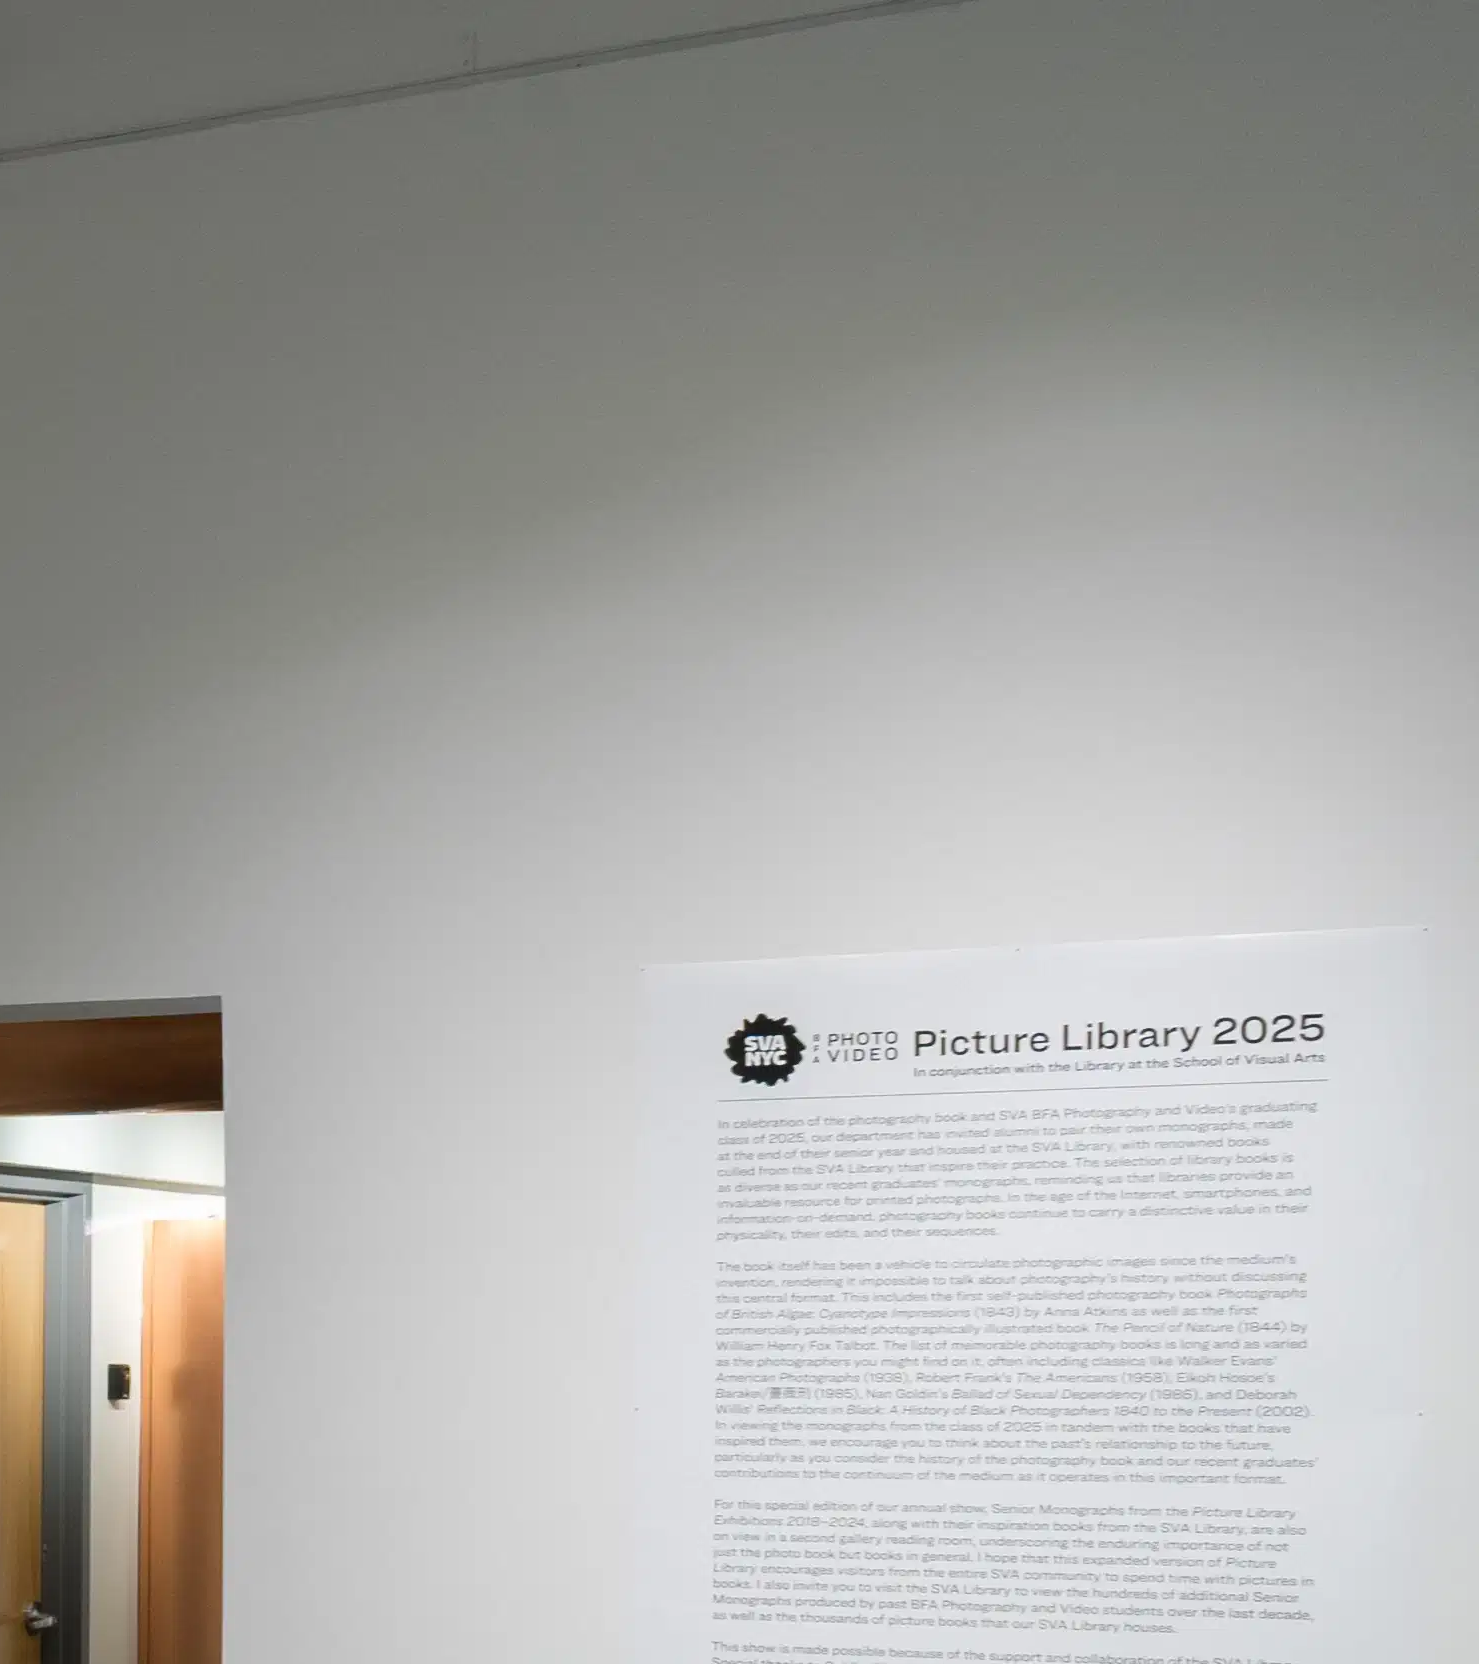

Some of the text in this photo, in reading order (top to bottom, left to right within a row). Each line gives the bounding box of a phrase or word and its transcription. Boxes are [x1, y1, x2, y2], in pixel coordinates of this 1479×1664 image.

[828, 1031, 898, 1046] PHOTO
[914, 1013, 1325, 1057] Picture Library 2025
[744, 1035, 786, 1051] SVA
[745, 1051, 787, 1066] NYC
[828, 1048, 898, 1062] VIDEO
[913, 1052, 1325, 1077] In conjunction with the Library at the School of Visual Arts
